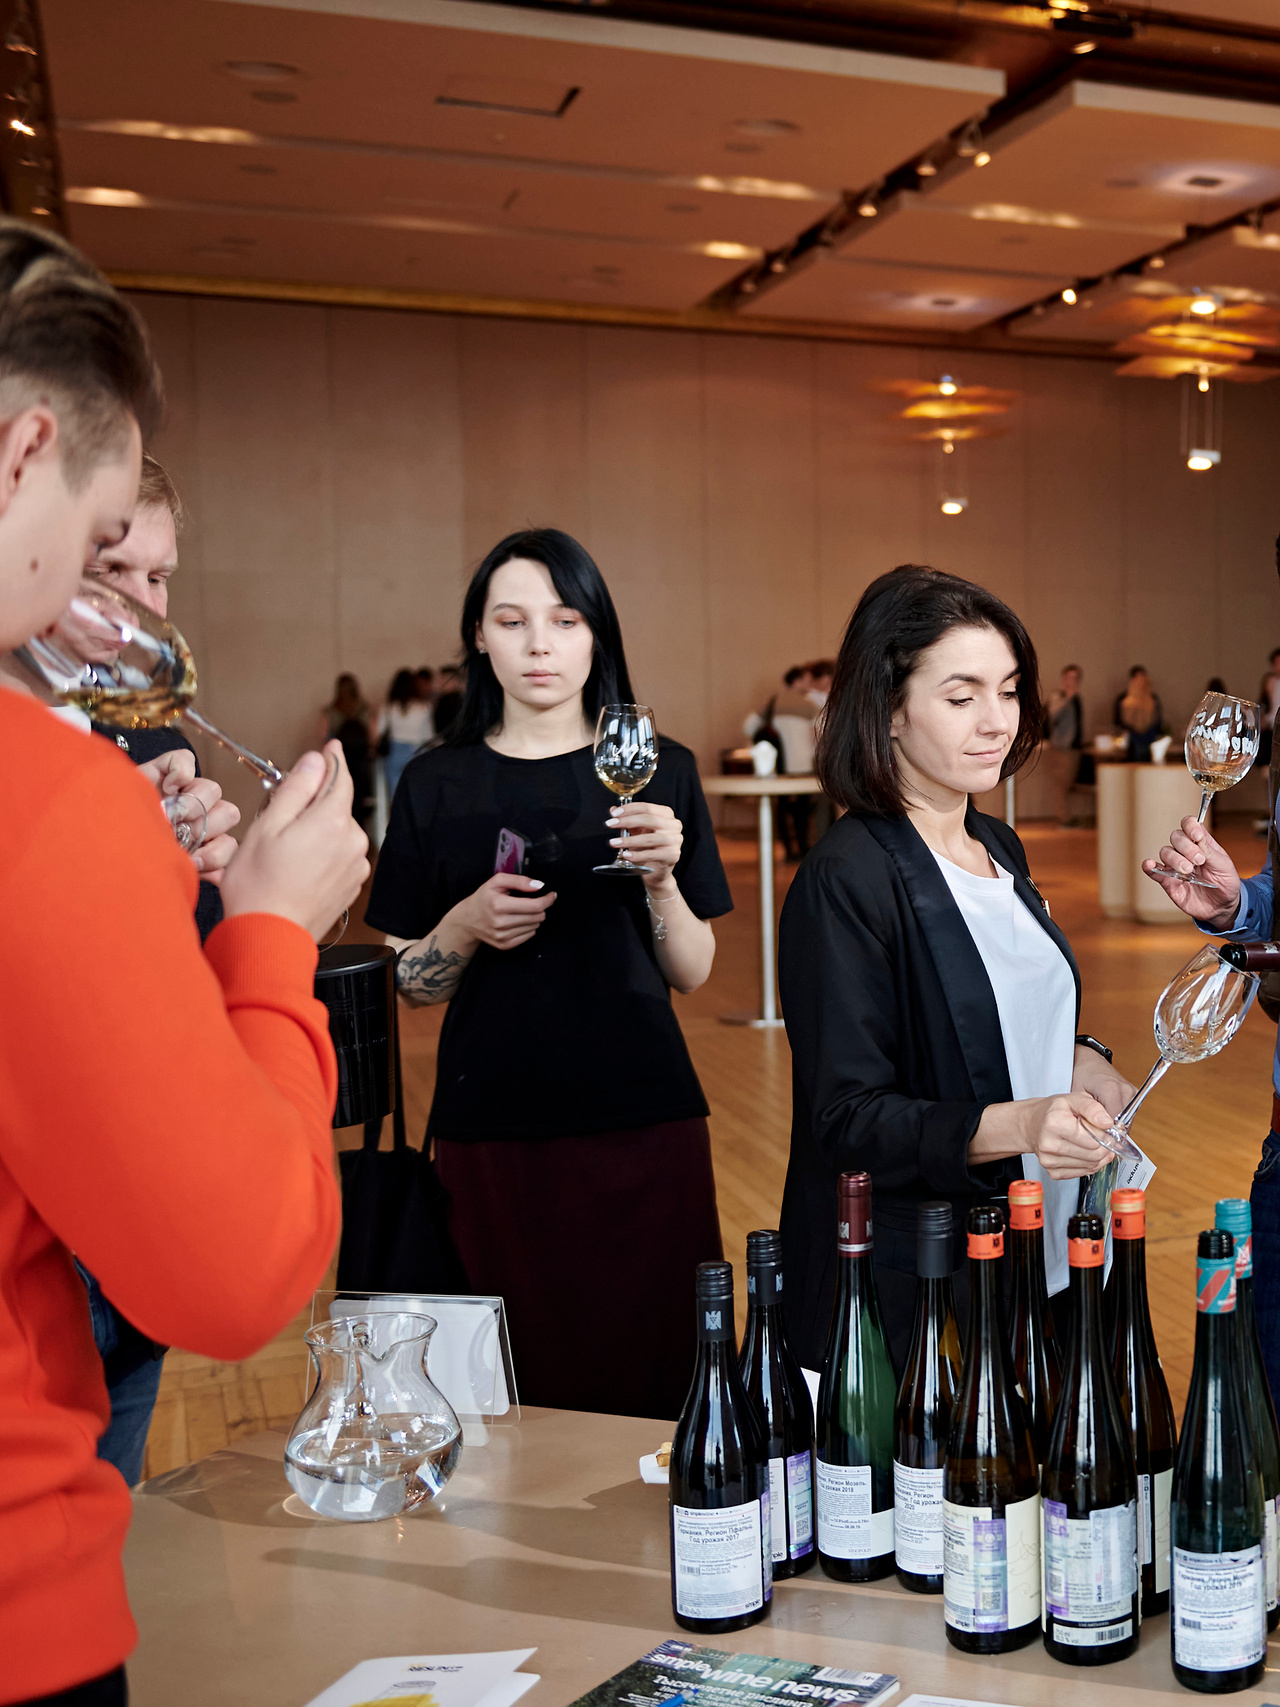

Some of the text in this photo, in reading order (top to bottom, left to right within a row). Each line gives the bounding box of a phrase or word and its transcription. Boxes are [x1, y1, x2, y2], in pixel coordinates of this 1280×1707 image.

[828, 1478, 844, 1486] Регион
[689, 1534, 740, 1544] Год урожая 2017
[1190, 1582, 1202, 1590] Год
[745, 1599, 760, 1608] simple
[653, 1674, 744, 1698] Тысячелетие
[744, 1692, 813, 1707] рислинга
[771, 1678, 860, 1702] news
